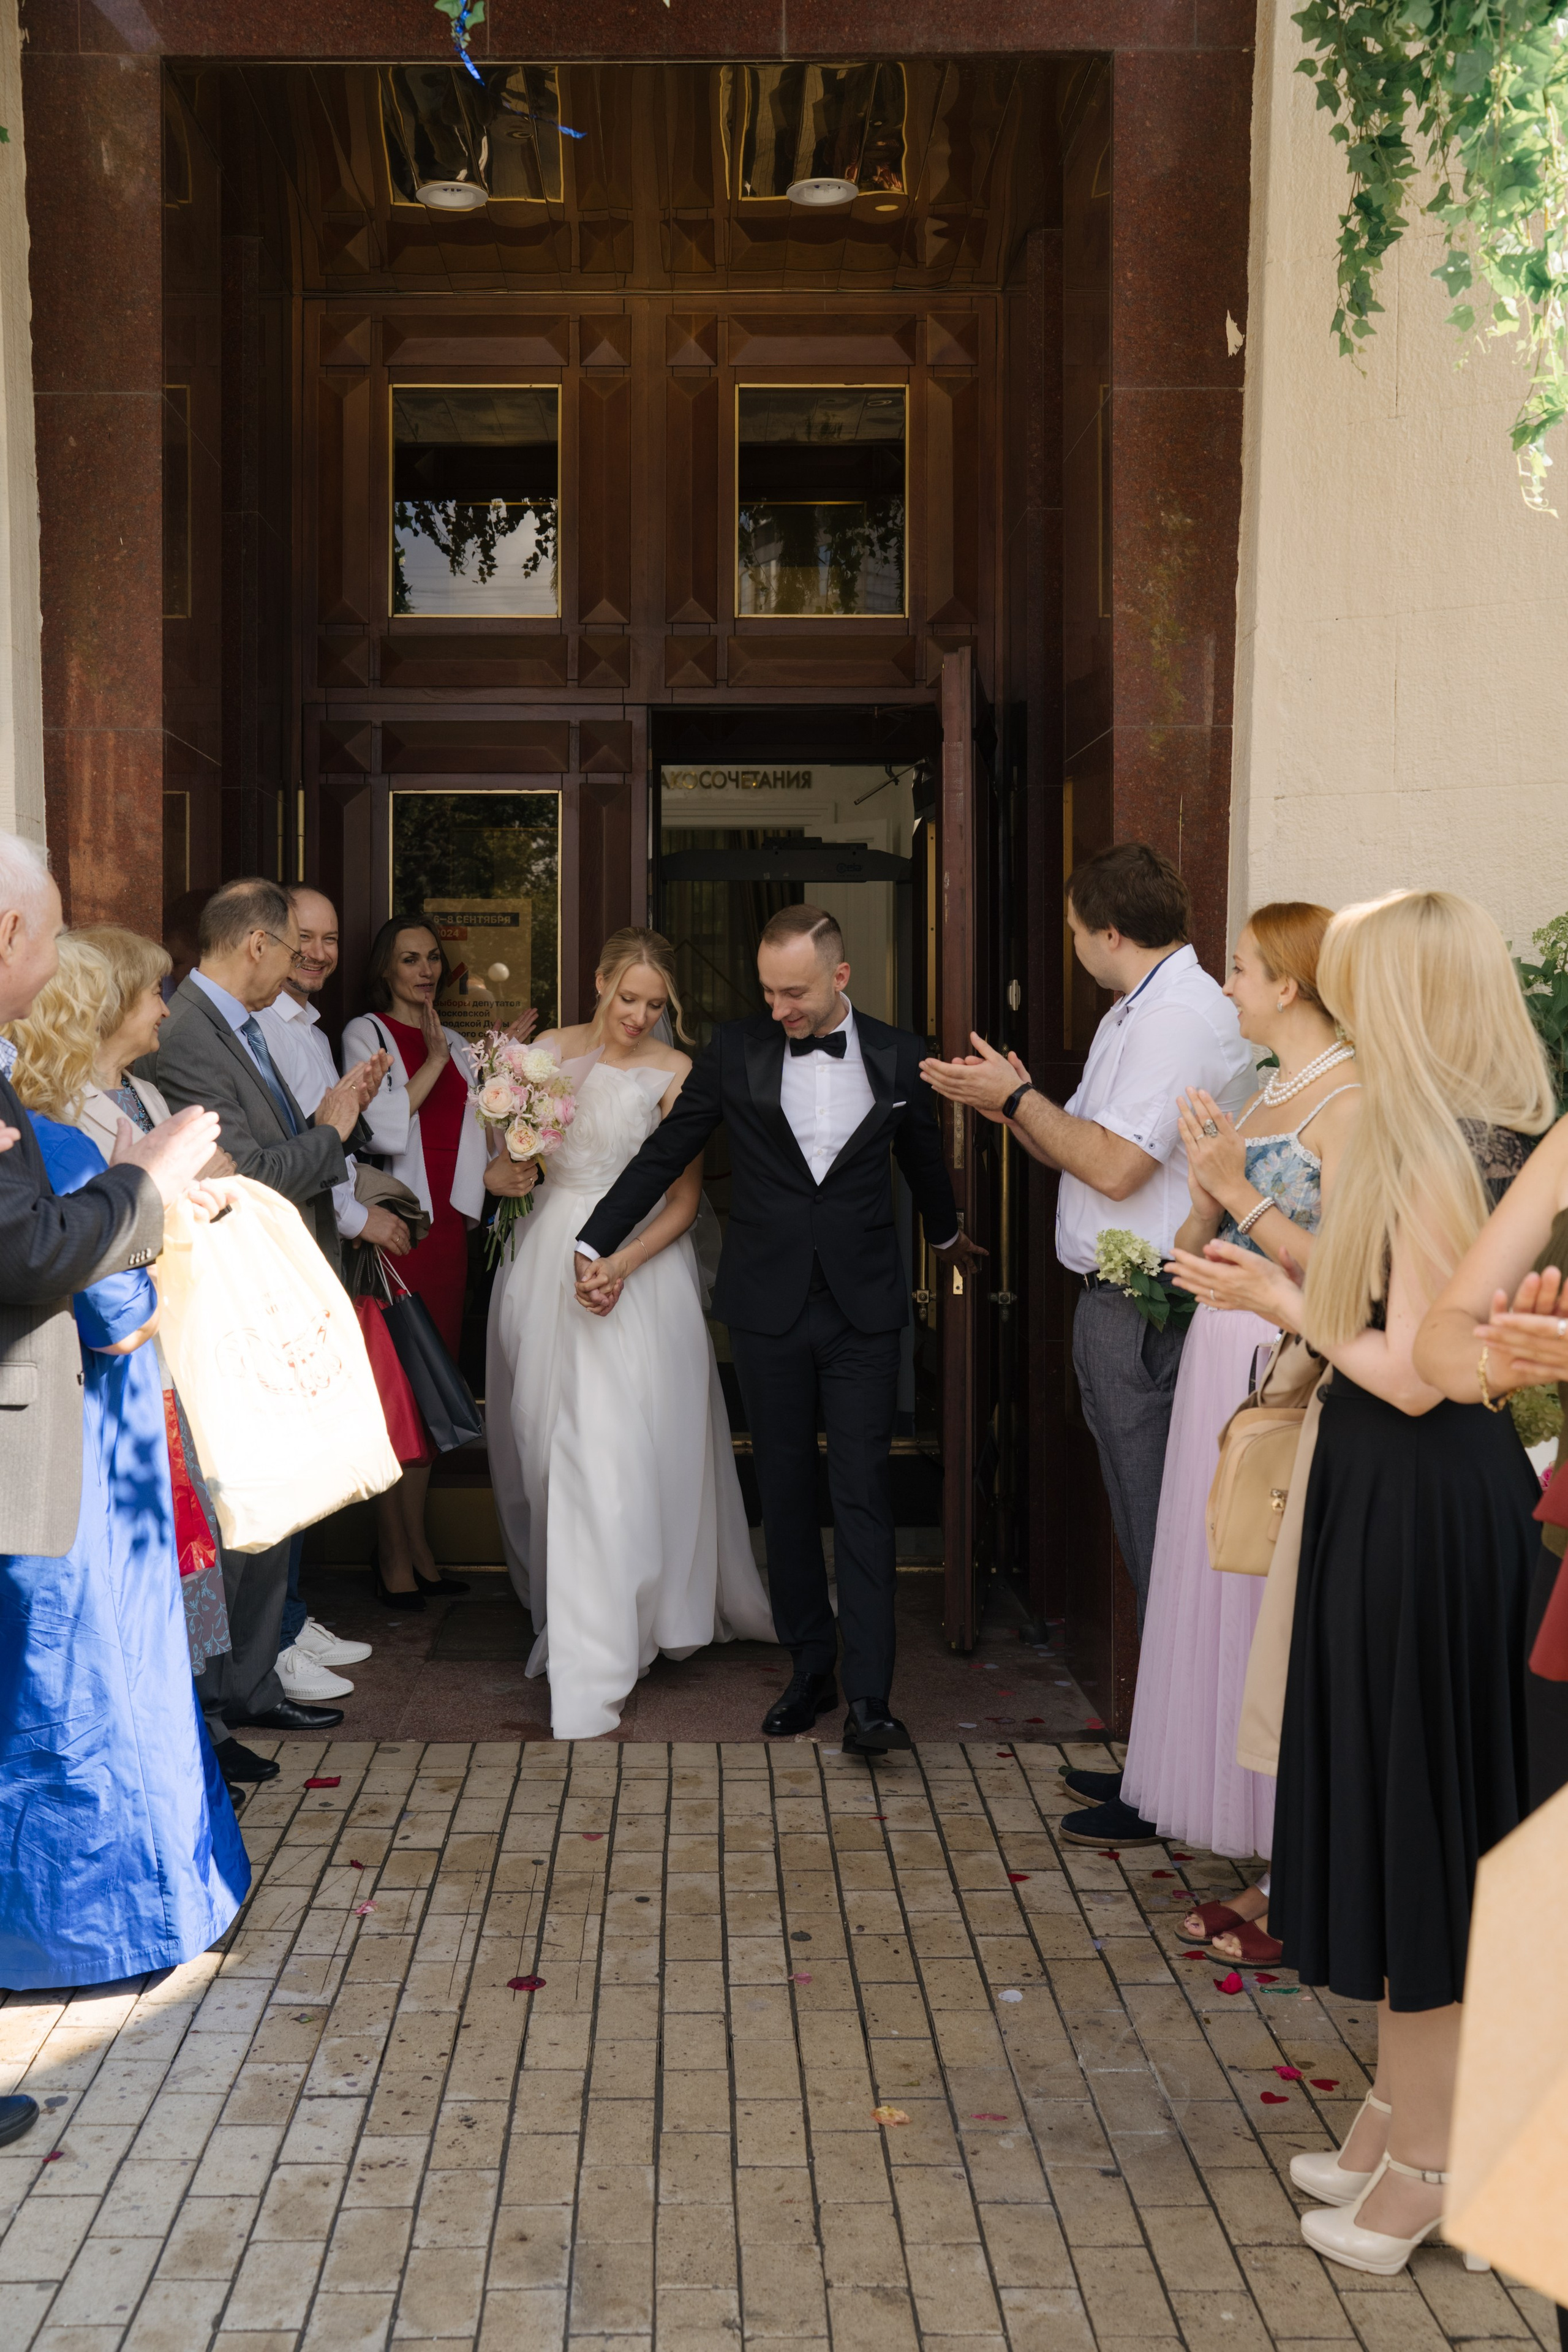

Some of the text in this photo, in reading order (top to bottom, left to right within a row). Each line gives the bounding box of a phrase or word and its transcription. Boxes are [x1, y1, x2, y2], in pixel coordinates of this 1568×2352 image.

[456, 915, 511, 924] СЕНТЯБРЯ
[438, 929, 459, 938] 024
[472, 1000, 521, 1009] депутатов
[483, 1020, 510, 1029] Дуы
